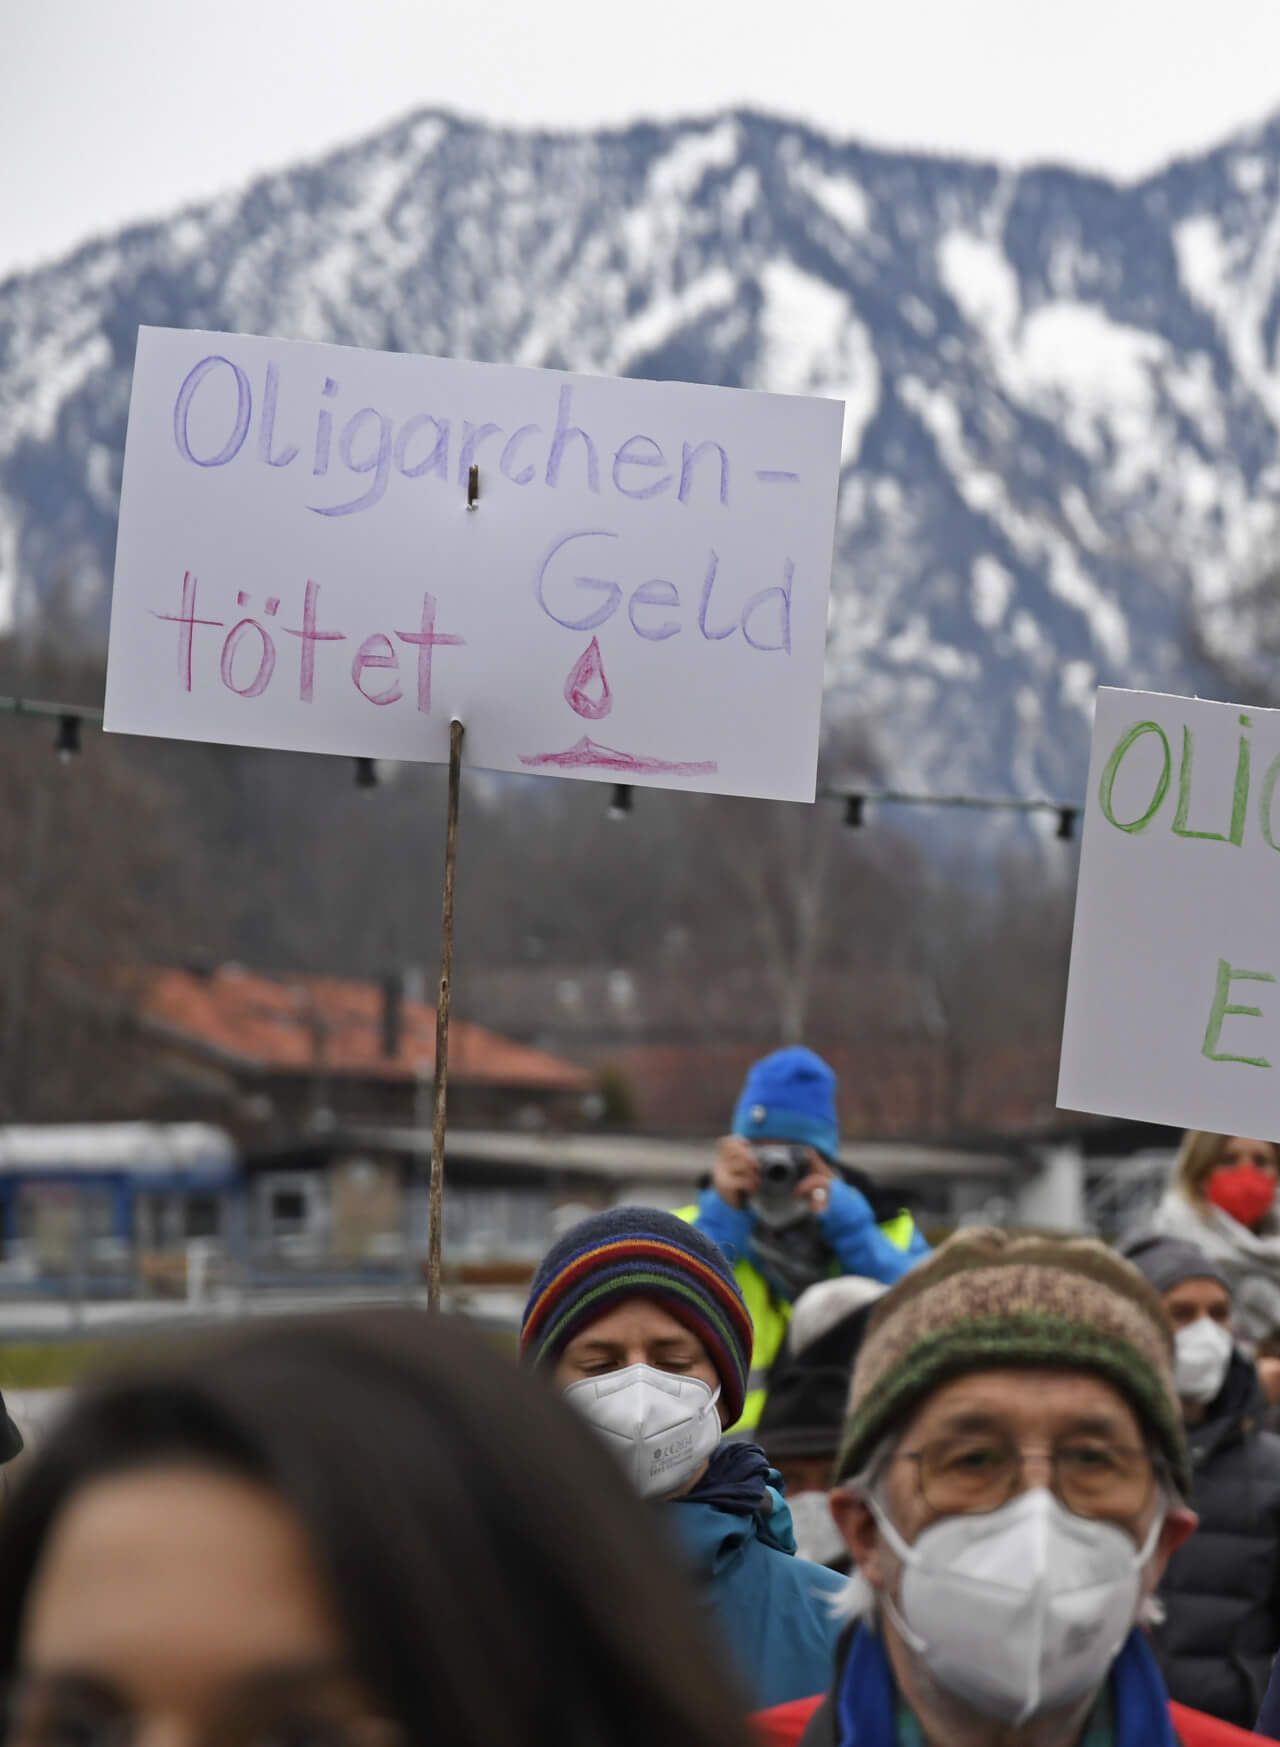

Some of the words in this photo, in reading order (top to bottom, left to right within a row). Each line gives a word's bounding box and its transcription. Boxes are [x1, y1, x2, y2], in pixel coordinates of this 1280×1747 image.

[174, 355, 799, 517] Oligarchen-
[150, 571, 467, 714] tötet
[538, 531, 794, 655] Geld
